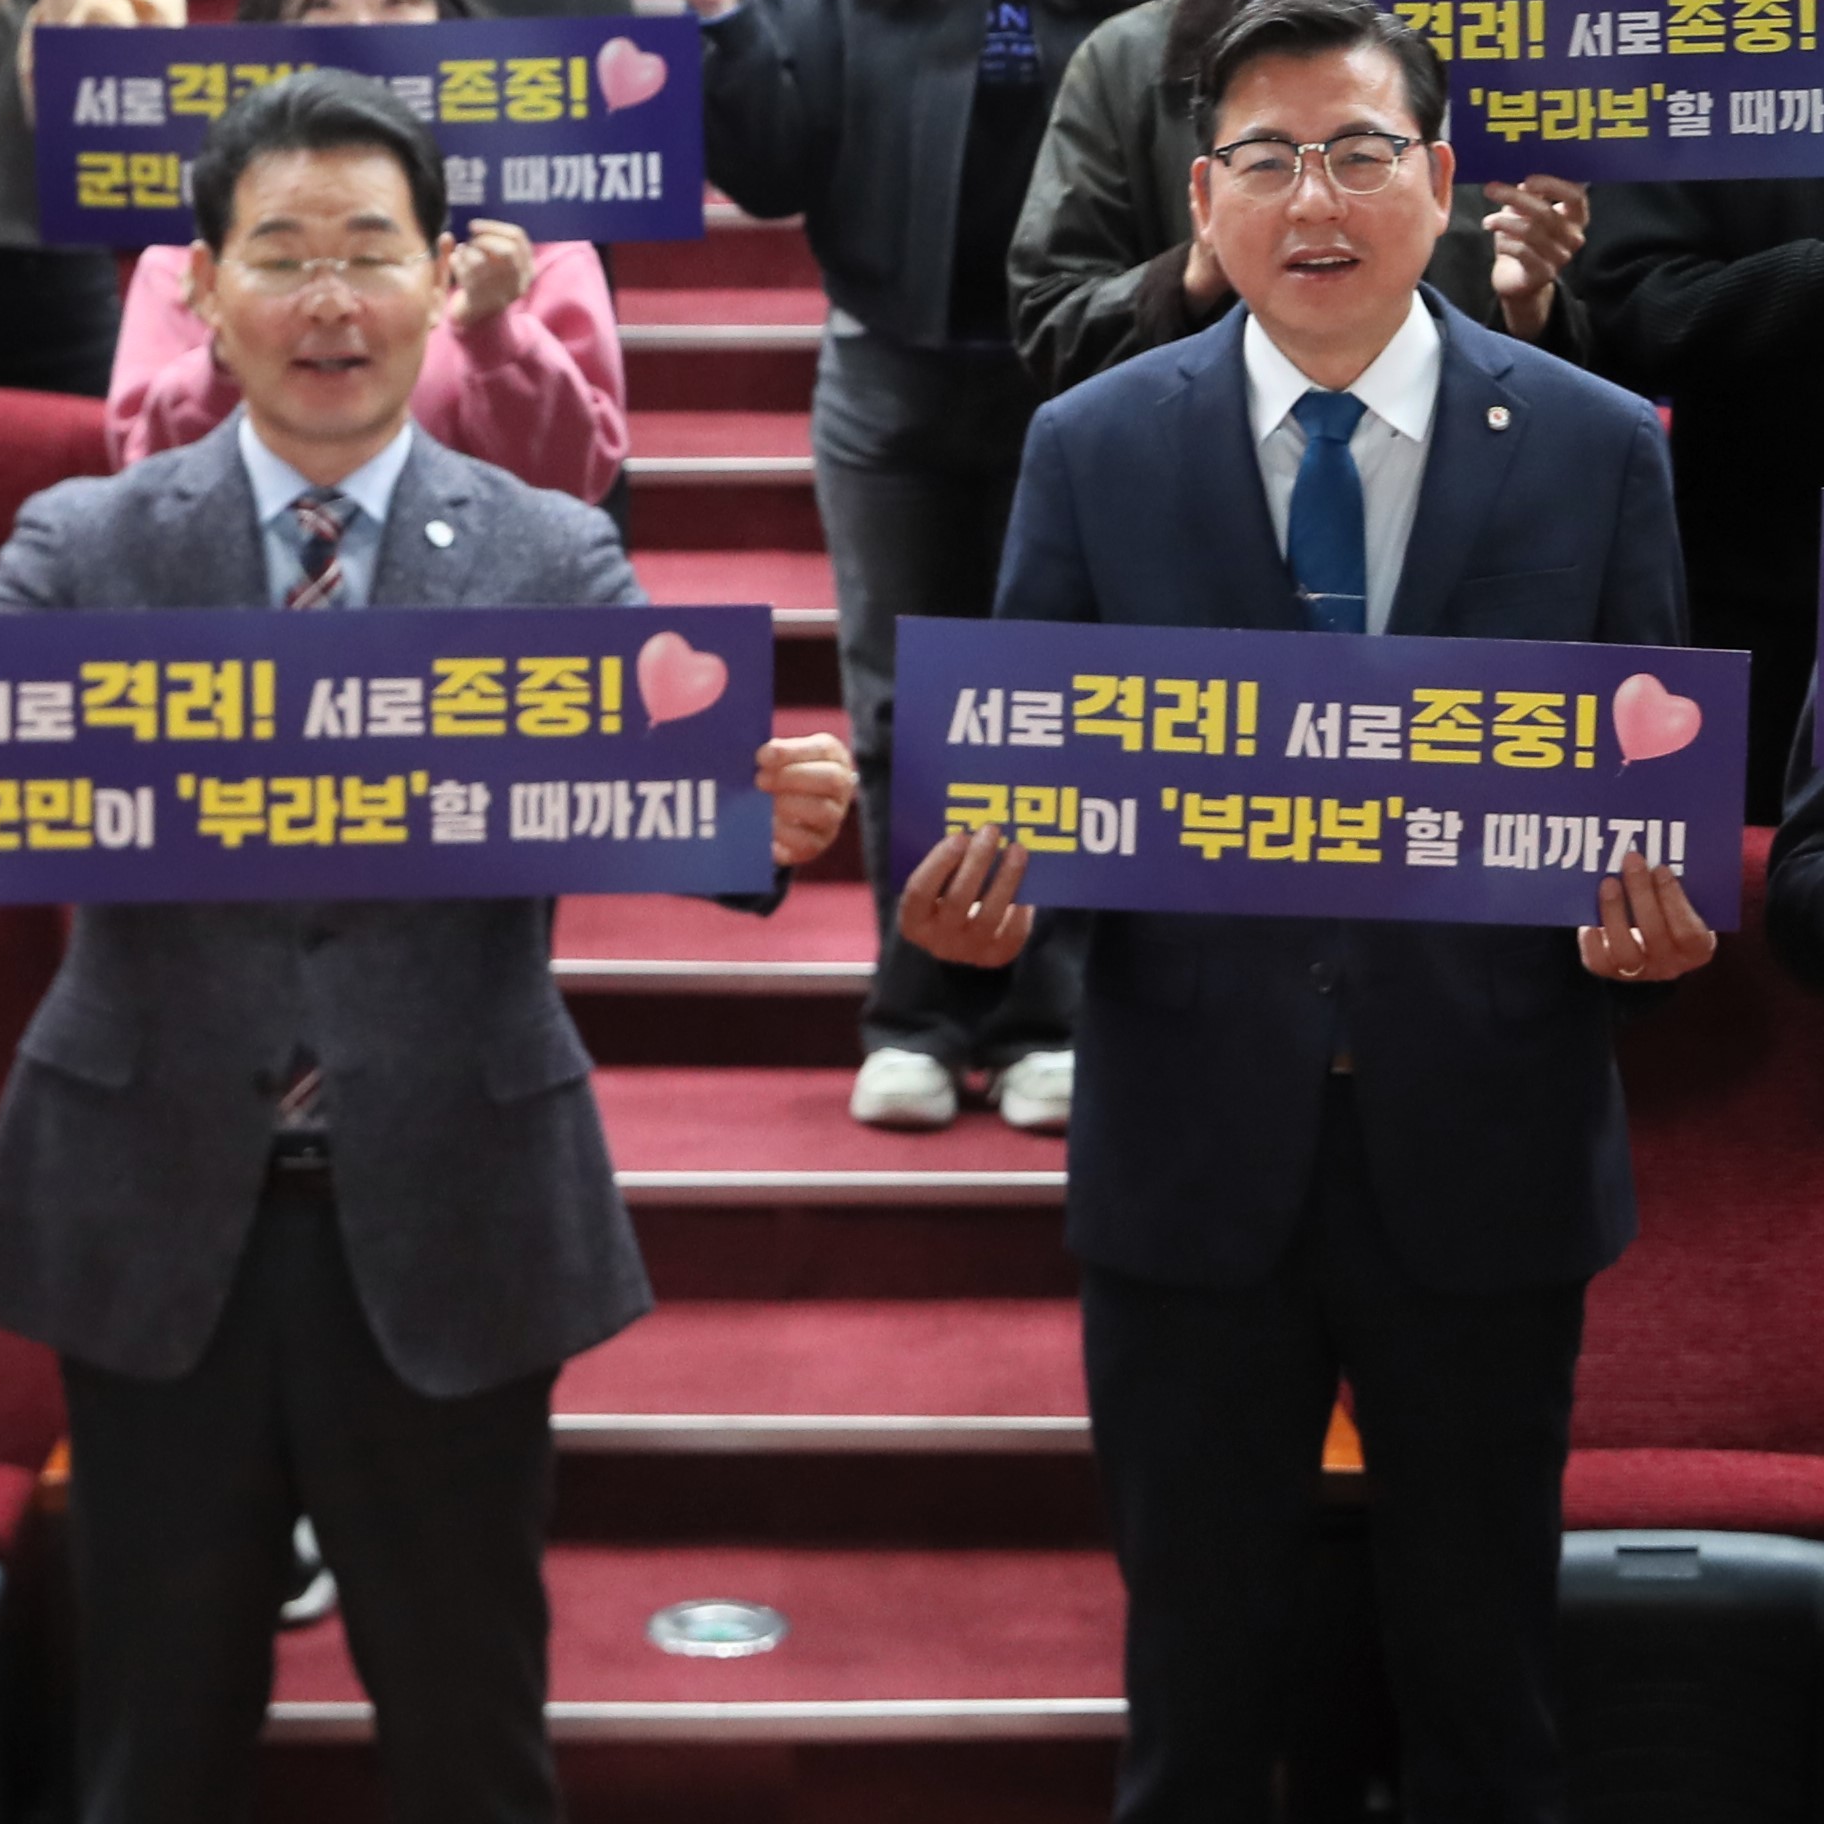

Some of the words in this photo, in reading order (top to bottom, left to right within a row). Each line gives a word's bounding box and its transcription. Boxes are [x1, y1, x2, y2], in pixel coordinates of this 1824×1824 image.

[1469, 82, 1715, 142] '부라보'할
[501, 152, 661, 201] 때까지!
[303, 656, 621, 738] 서로존중!
[947, 674, 1259, 756] 서로격려!
[1285, 686, 1598, 768] 서로존중!
[177, 770, 490, 847] '부라보'할
[510, 779, 716, 840] 때까지!
[1160, 788, 1463, 868] '부라보'할
[1482, 814, 1686, 876] 때까지!
